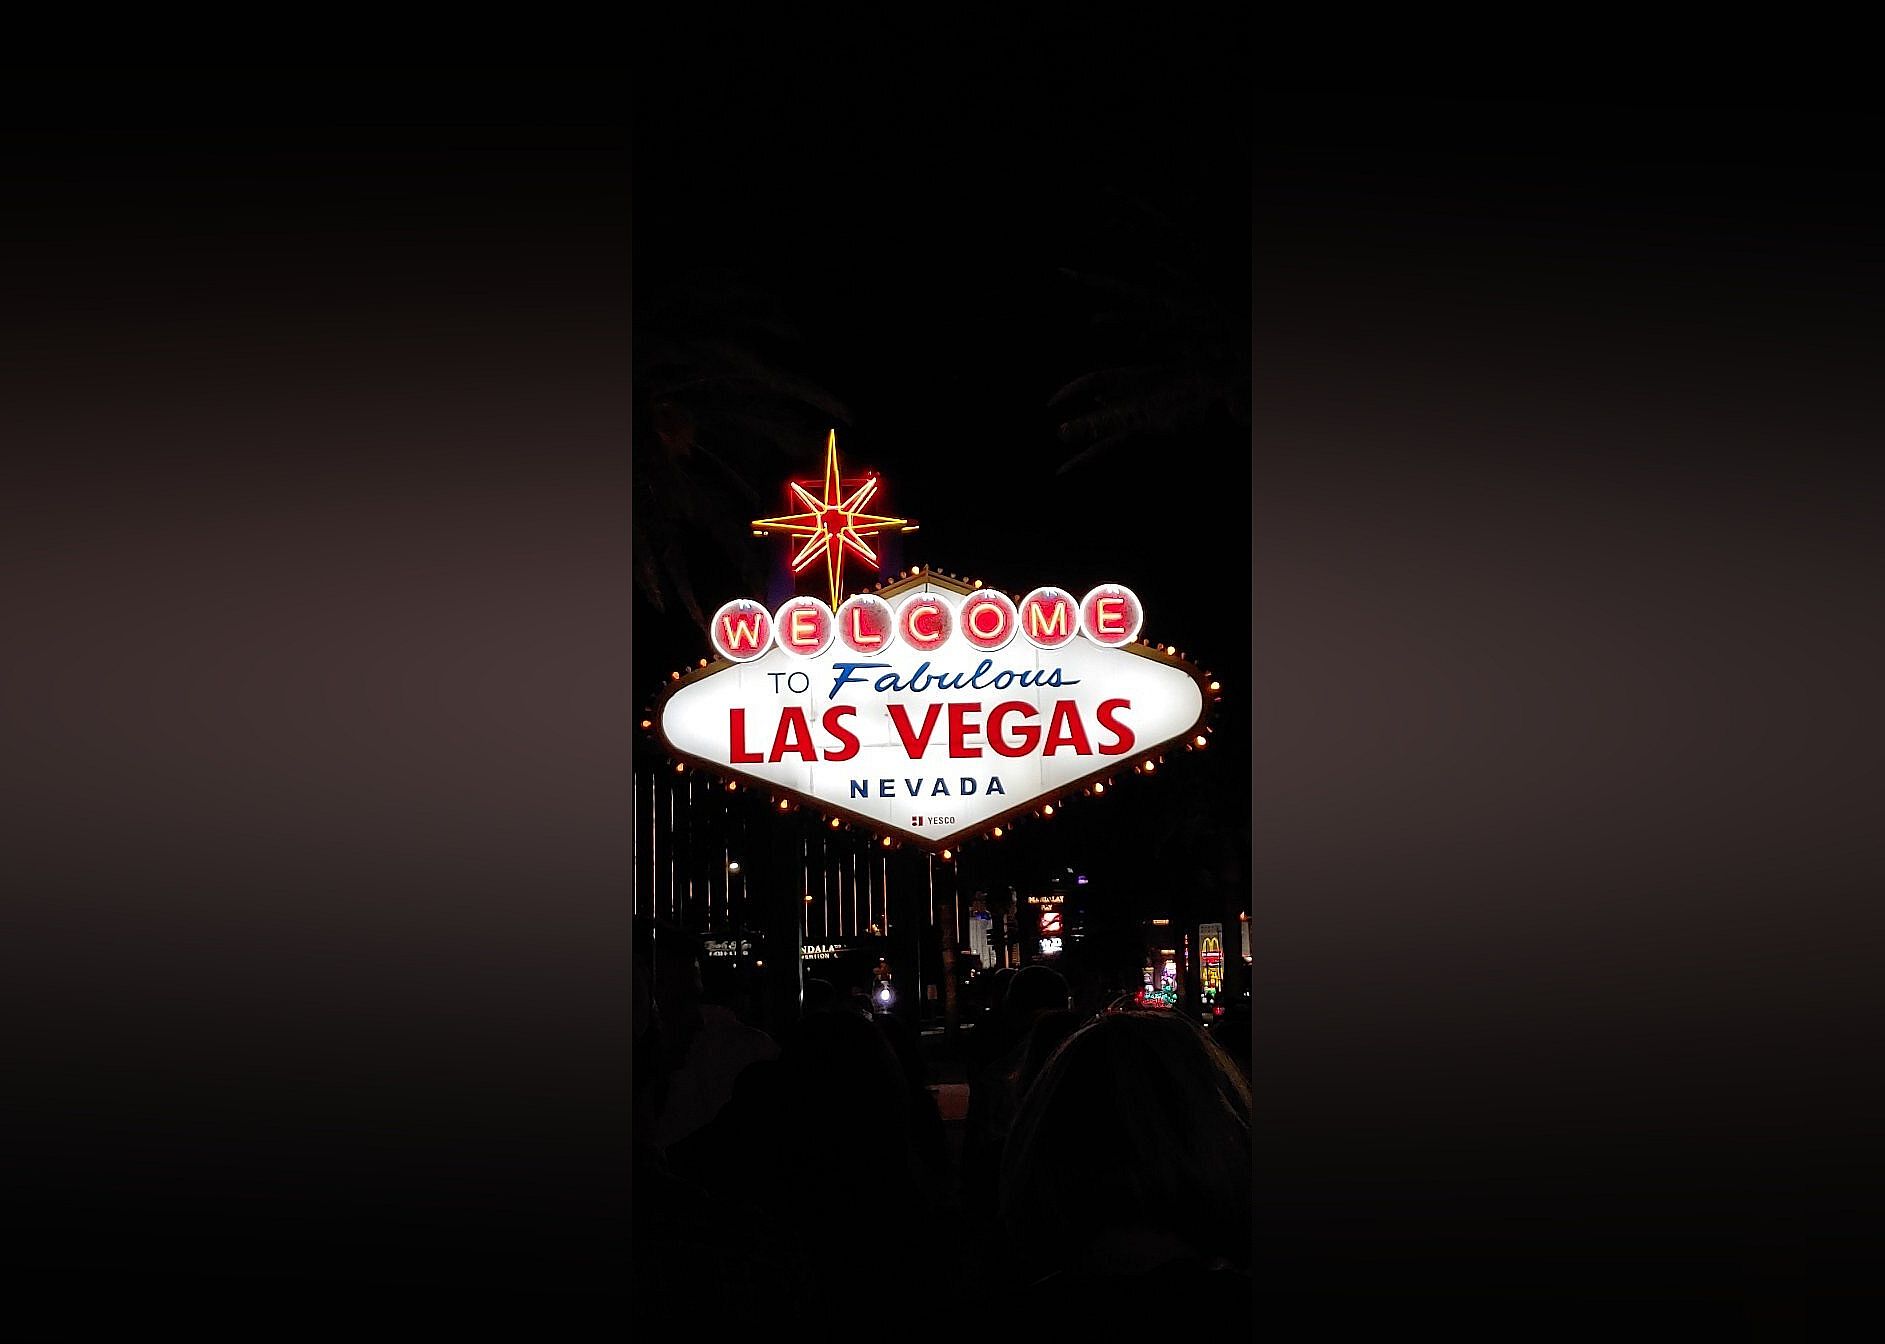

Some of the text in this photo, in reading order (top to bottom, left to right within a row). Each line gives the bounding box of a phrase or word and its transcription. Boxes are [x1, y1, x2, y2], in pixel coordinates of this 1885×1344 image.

[721, 596, 1127, 651] WELCOME
[767, 658, 1080, 700] TO Fabulous
[729, 698, 1136, 764] LAS VEGAS
[849, 776, 1006, 799] NEVADA
[927, 816, 955, 825] YESCO
